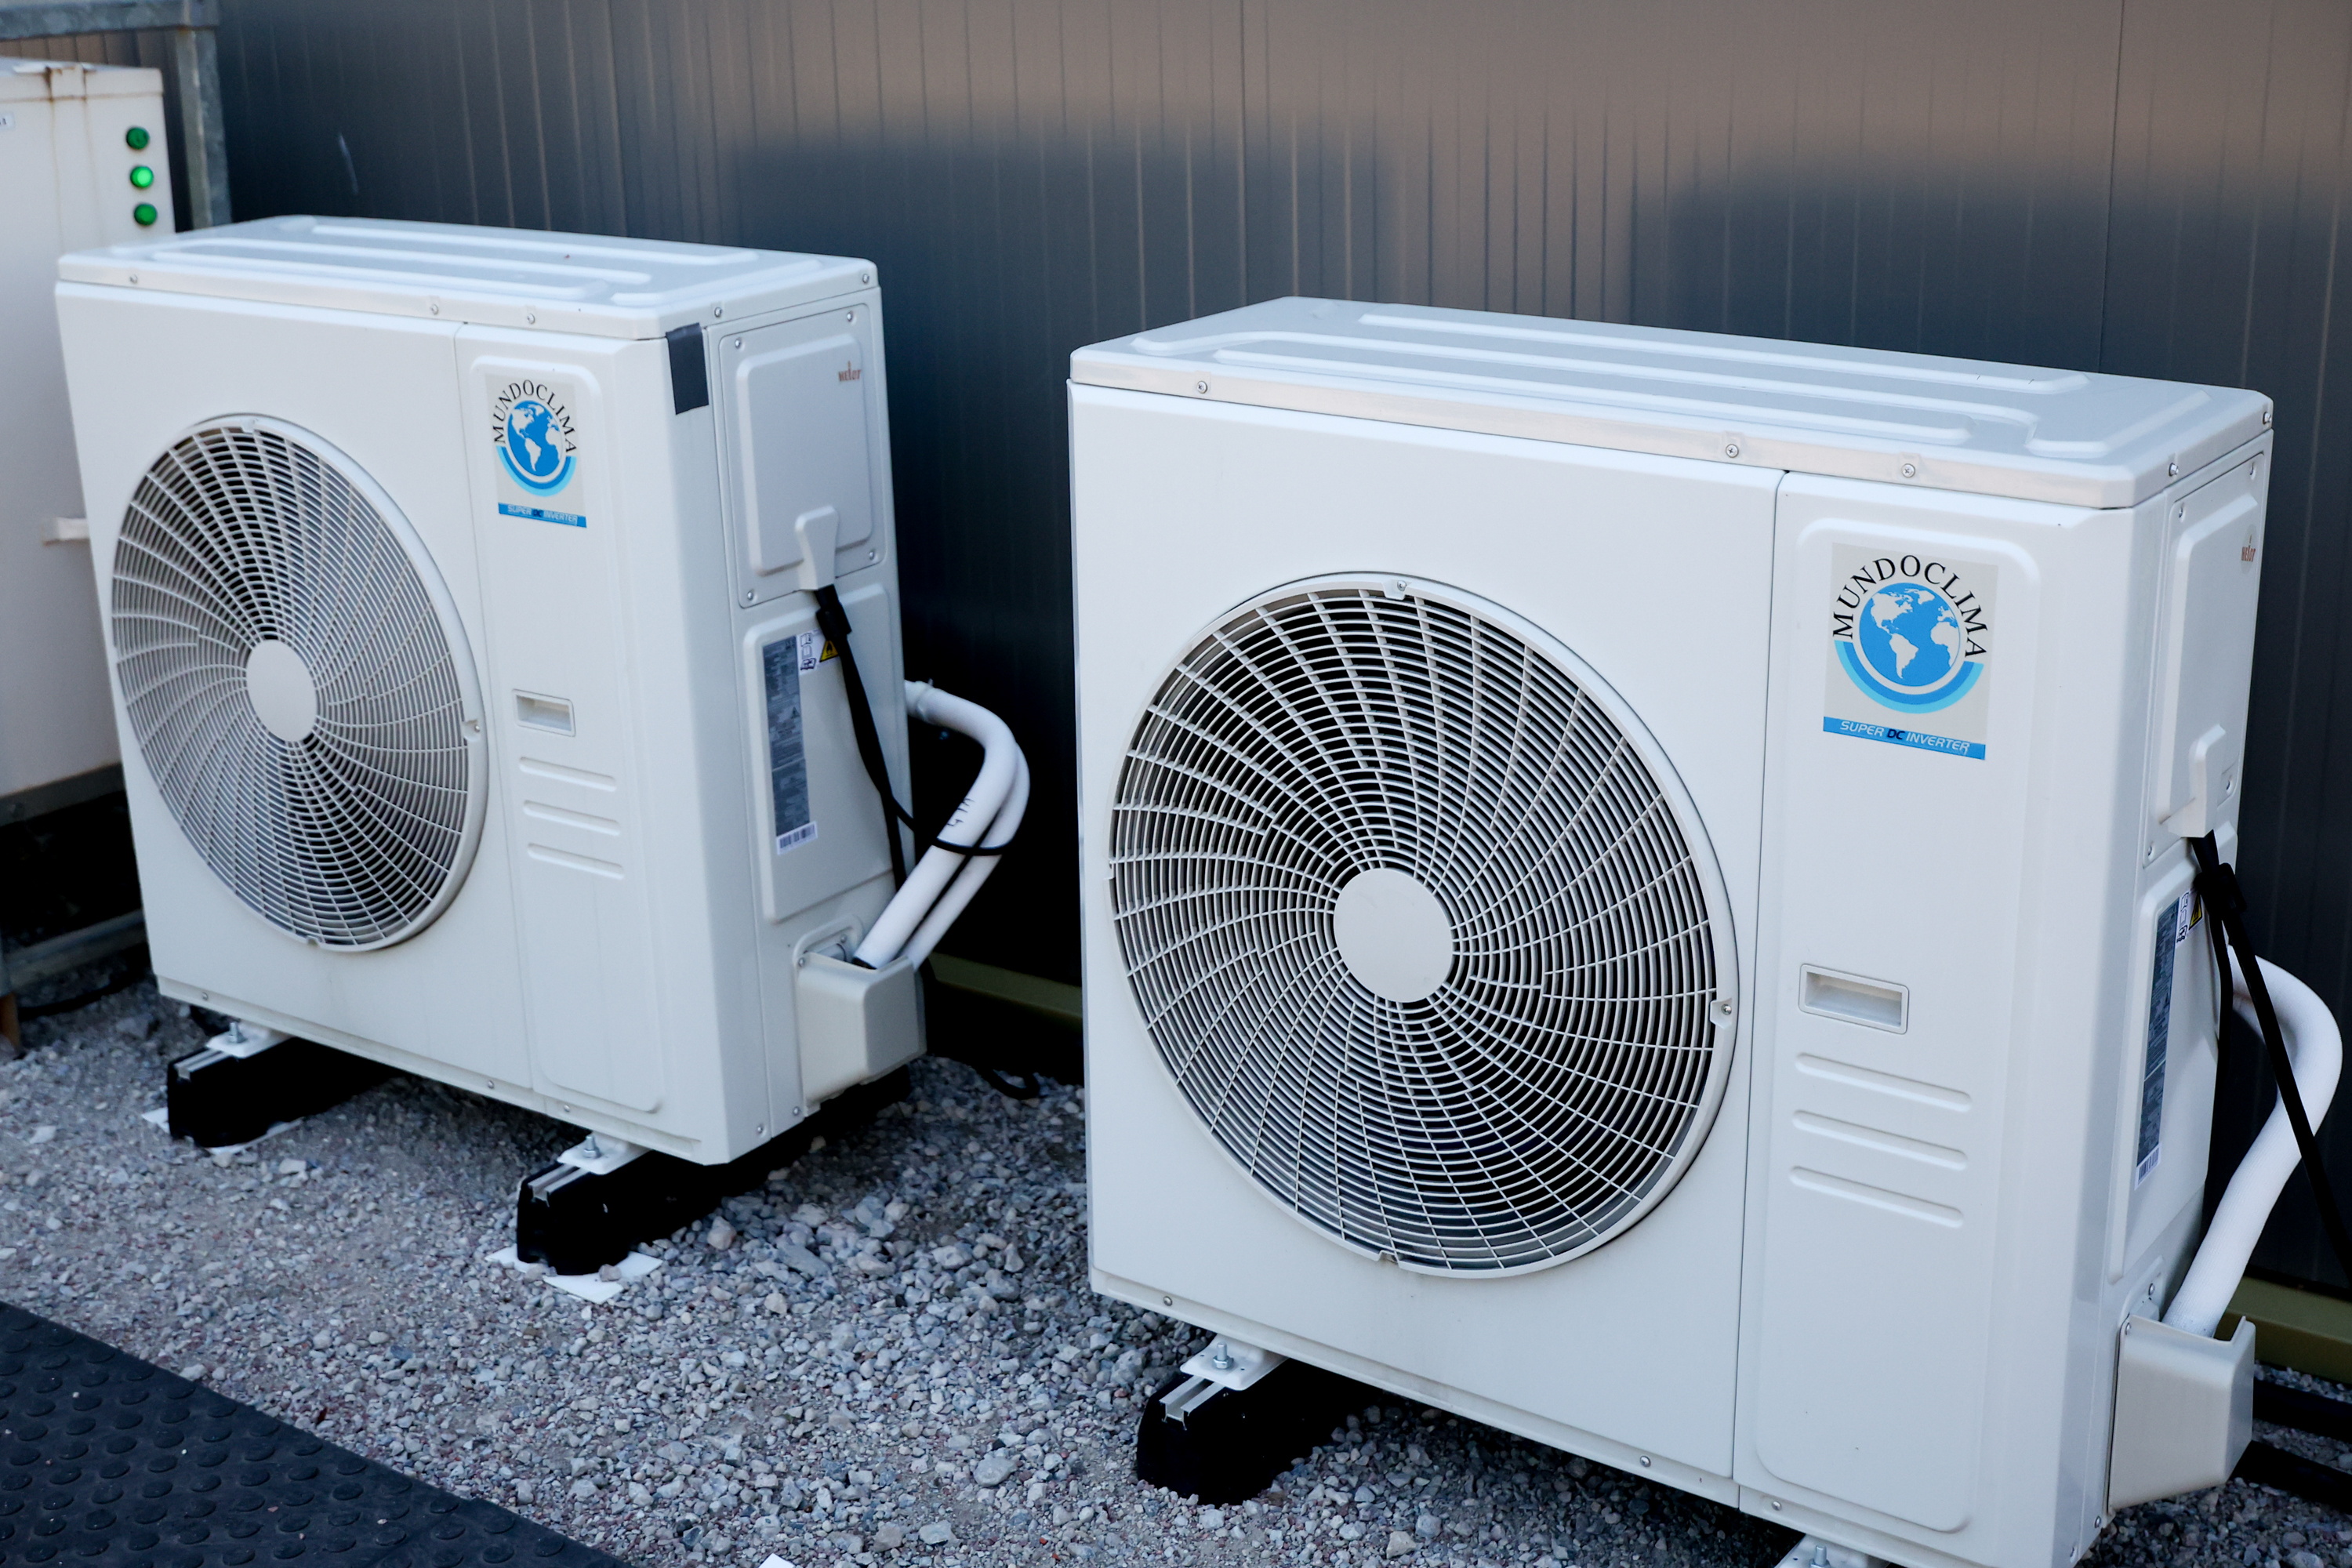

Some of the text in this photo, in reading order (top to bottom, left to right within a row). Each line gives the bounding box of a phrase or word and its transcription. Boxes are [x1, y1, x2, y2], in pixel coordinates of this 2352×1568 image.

[492, 379, 576, 452] MUNDOCLIMA
[507, 504, 577, 525] SUPER DC INVERTER
[1832, 555, 1987, 657] MUNDOCLIMA
[1840, 720, 1970, 755] SUPER DC INVERTER
